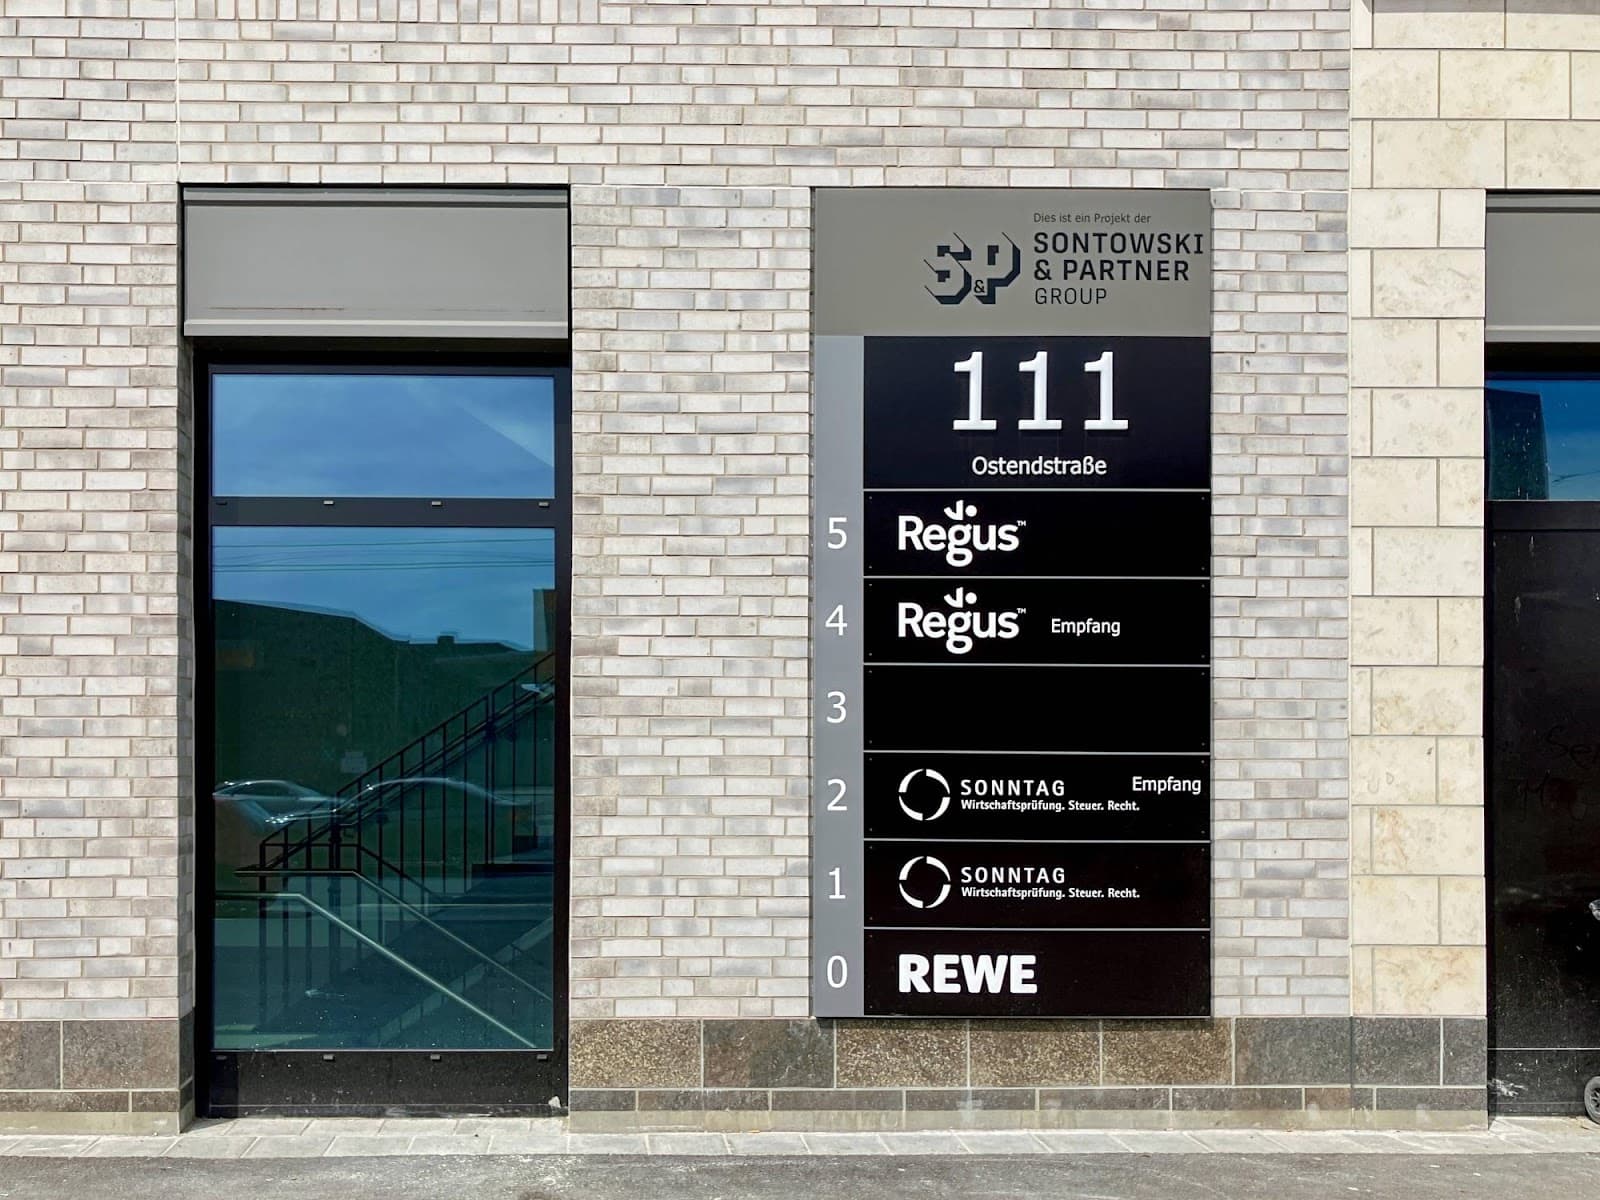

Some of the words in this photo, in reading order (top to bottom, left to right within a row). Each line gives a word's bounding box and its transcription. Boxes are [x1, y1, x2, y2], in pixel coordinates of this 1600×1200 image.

[1034, 213, 1056, 222] Dies
[1060, 213, 1072, 223] ist
[1075, 213, 1090, 223] ein
[1094, 213, 1130, 225] Projekt
[1134, 213, 1151, 224] der
[1034, 232, 1203, 254] SONTOWSKI
[1034, 259, 1052, 280] &
[1064, 260, 1189, 281] PARTNER
[1035, 288, 1107, 304] GROUP
[972, 456, 1106, 475] Ostendstraße
[828, 517, 846, 549] 5
[826, 605, 847, 635] 4
[1052, 618, 1120, 636] Empfang
[827, 691, 846, 723] 3
[828, 779, 847, 810] 2
[961, 780, 1064, 796] SONNTAG
[1133, 776, 1201, 794] Empfang
[961, 800, 1064, 812] Wirtschaftsprüfung.
[1069, 800, 1104, 810] Steuer.
[1108, 800, 1139, 810] Recht.
[829, 868, 845, 899] 1
[961, 867, 1064, 883] SONNTAG
[962, 887, 1065, 900] Wirtschaftsprüfung.
[1069, 888, 1104, 897] Steuer.
[1108, 888, 1139, 897] Recht.
[828, 956, 847, 988] 0
[899, 954, 1037, 993] REWE
